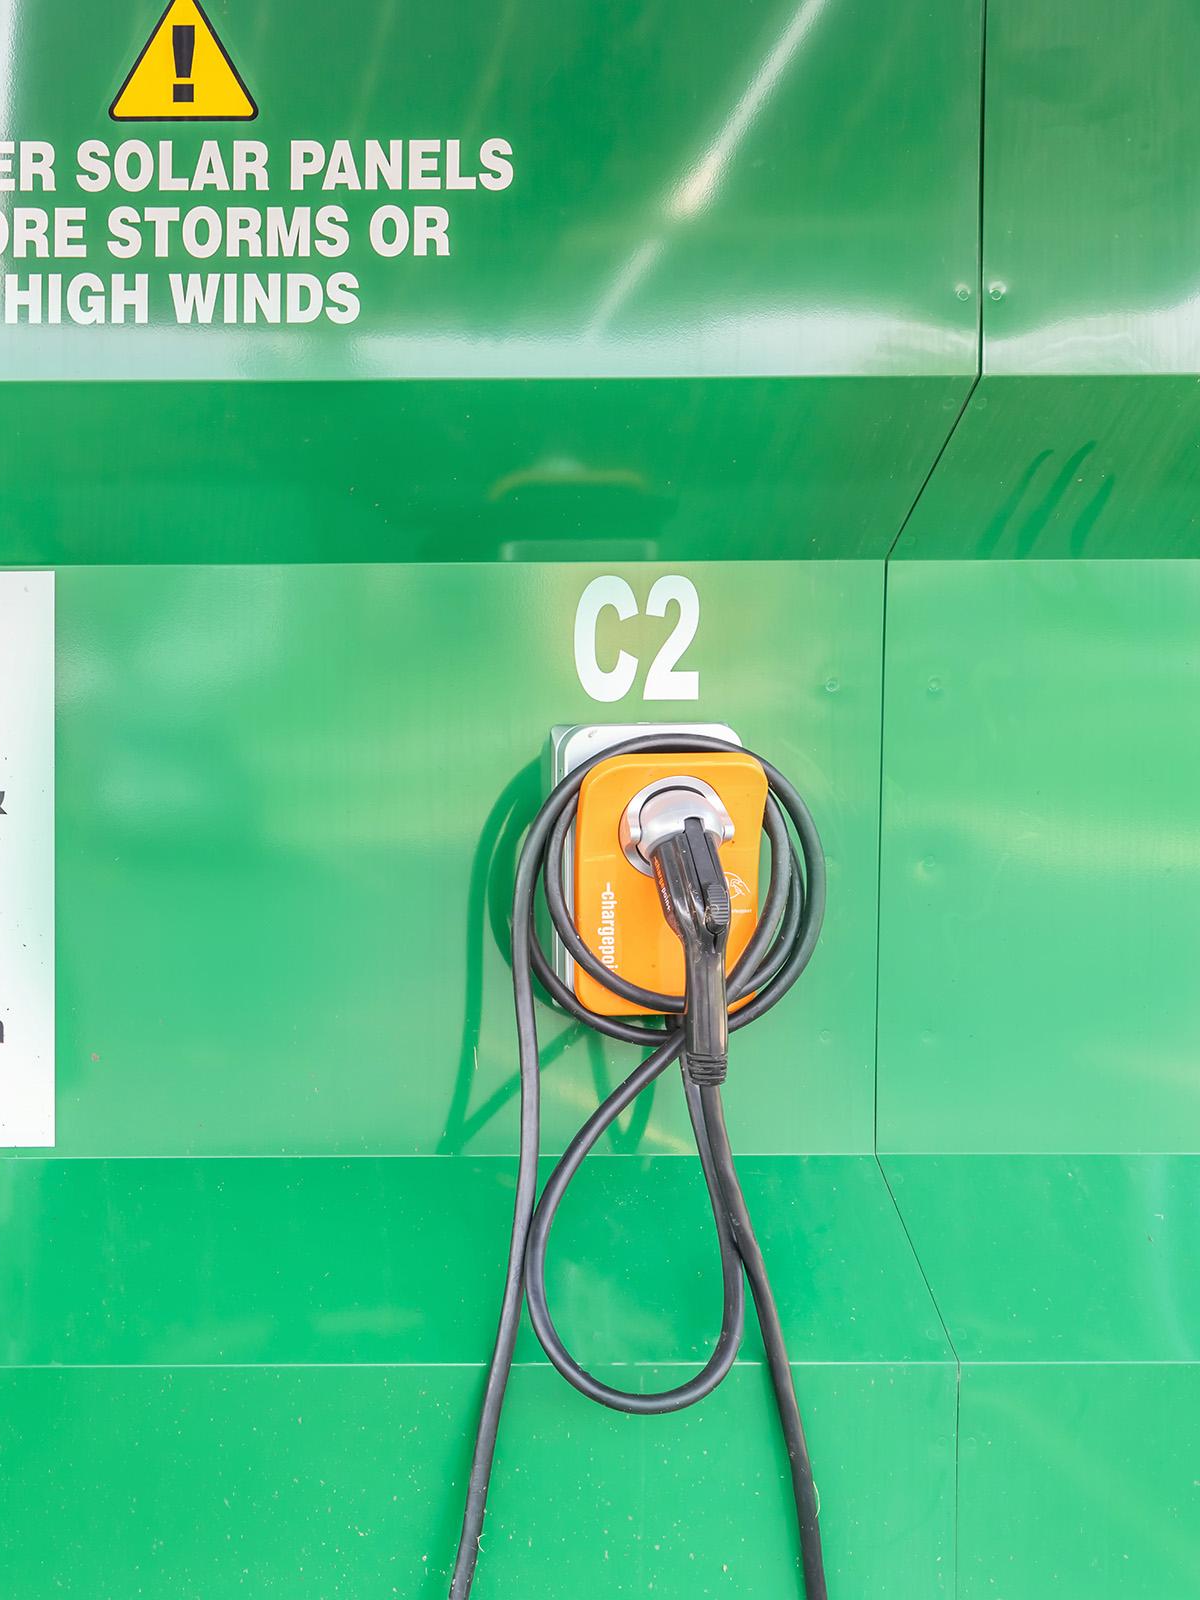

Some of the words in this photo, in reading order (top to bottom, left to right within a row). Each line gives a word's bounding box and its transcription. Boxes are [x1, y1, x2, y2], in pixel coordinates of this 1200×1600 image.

[76, 139, 270, 192] SOLAR
[290, 138, 514, 191] PANELS
[107, 205, 350, 258] STORMS
[369, 205, 450, 257] OR
[4, 272, 149, 325] HIGH
[169, 271, 360, 324] WINDS
[574, 575, 700, 703] C2
